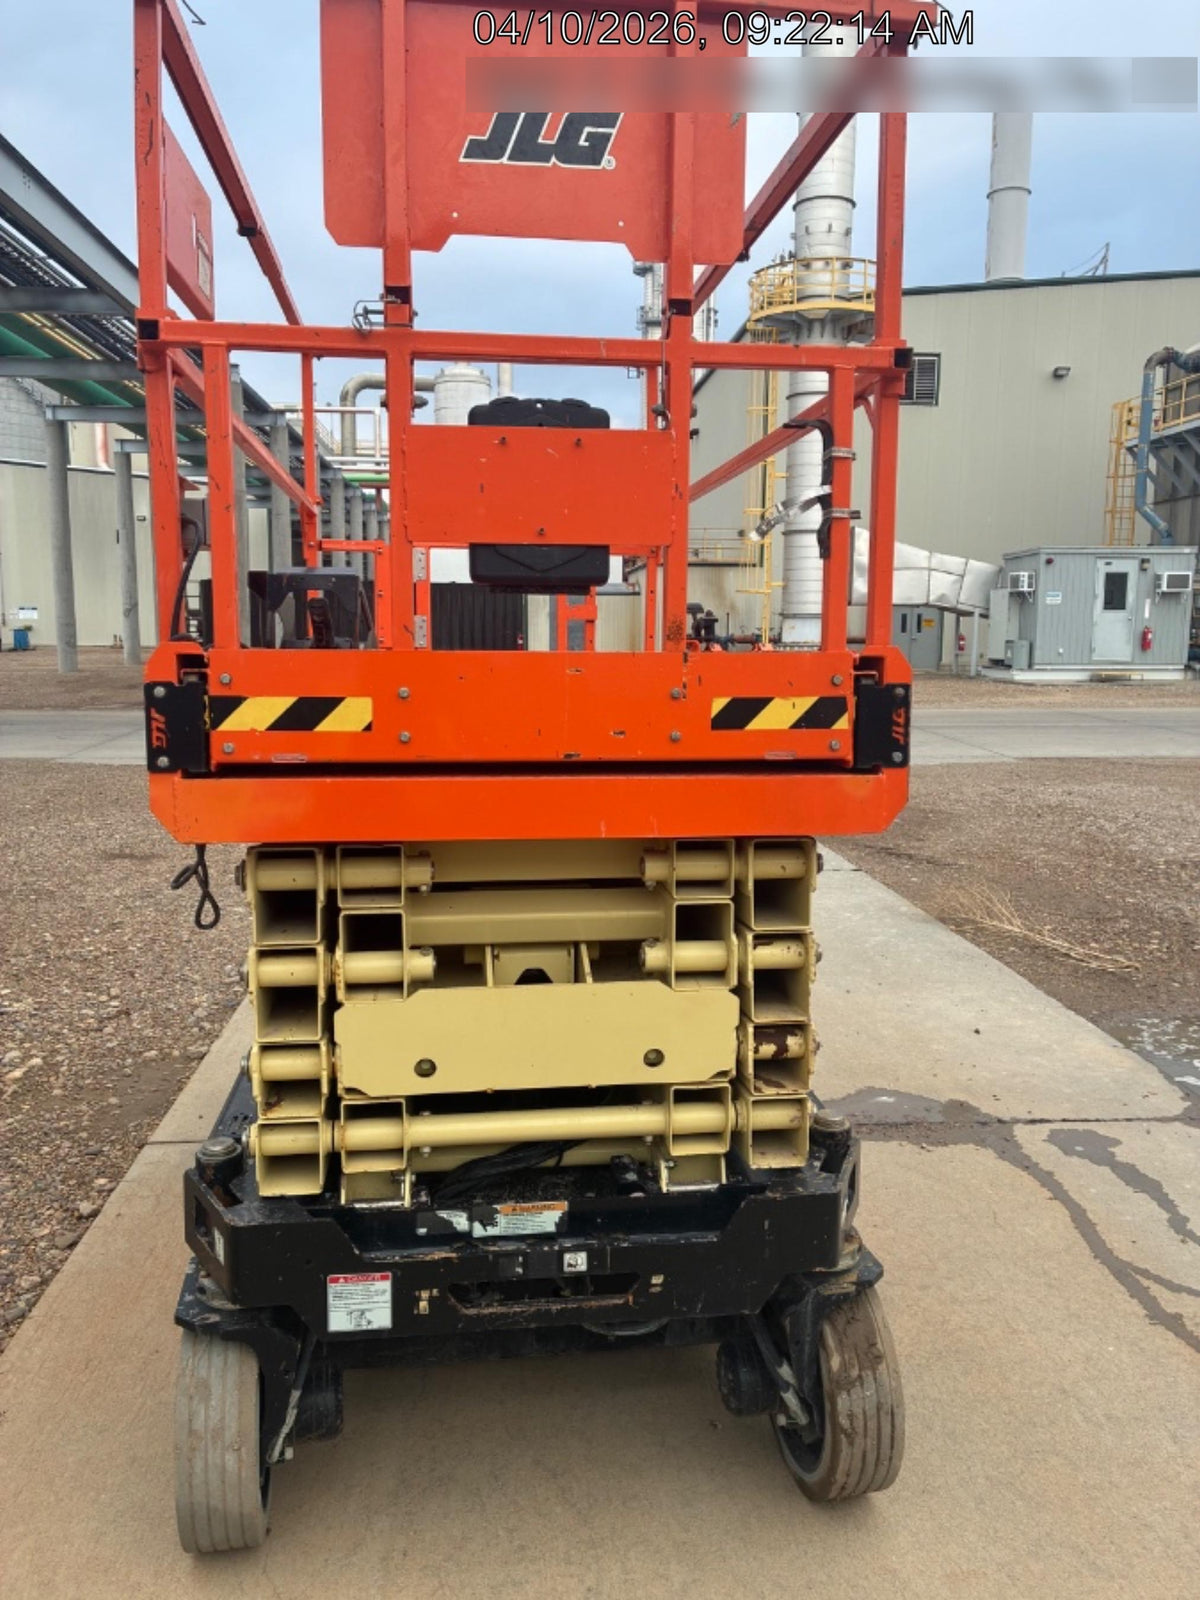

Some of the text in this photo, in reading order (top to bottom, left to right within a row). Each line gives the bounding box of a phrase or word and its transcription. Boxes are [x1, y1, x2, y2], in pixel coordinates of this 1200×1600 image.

[458, 112, 624, 170] JLG
[150, 708, 167, 749] JLG
[891, 707, 907, 745] JLG
